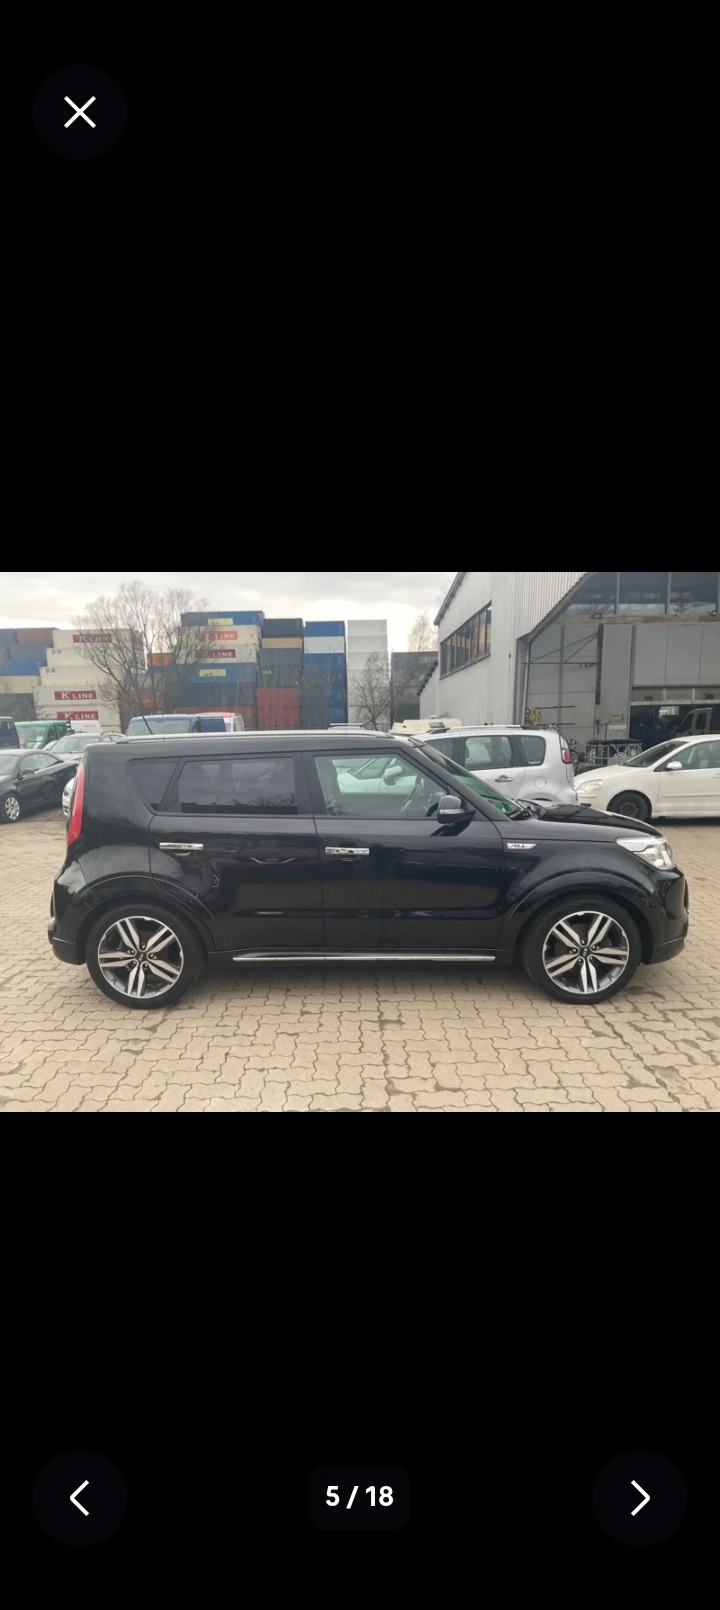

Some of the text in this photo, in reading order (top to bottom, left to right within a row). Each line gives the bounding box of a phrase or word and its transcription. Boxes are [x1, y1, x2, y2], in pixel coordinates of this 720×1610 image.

[214, 632, 236, 640] LINE
[61, 691, 71, 700] K
[64, 711, 72, 720] K
